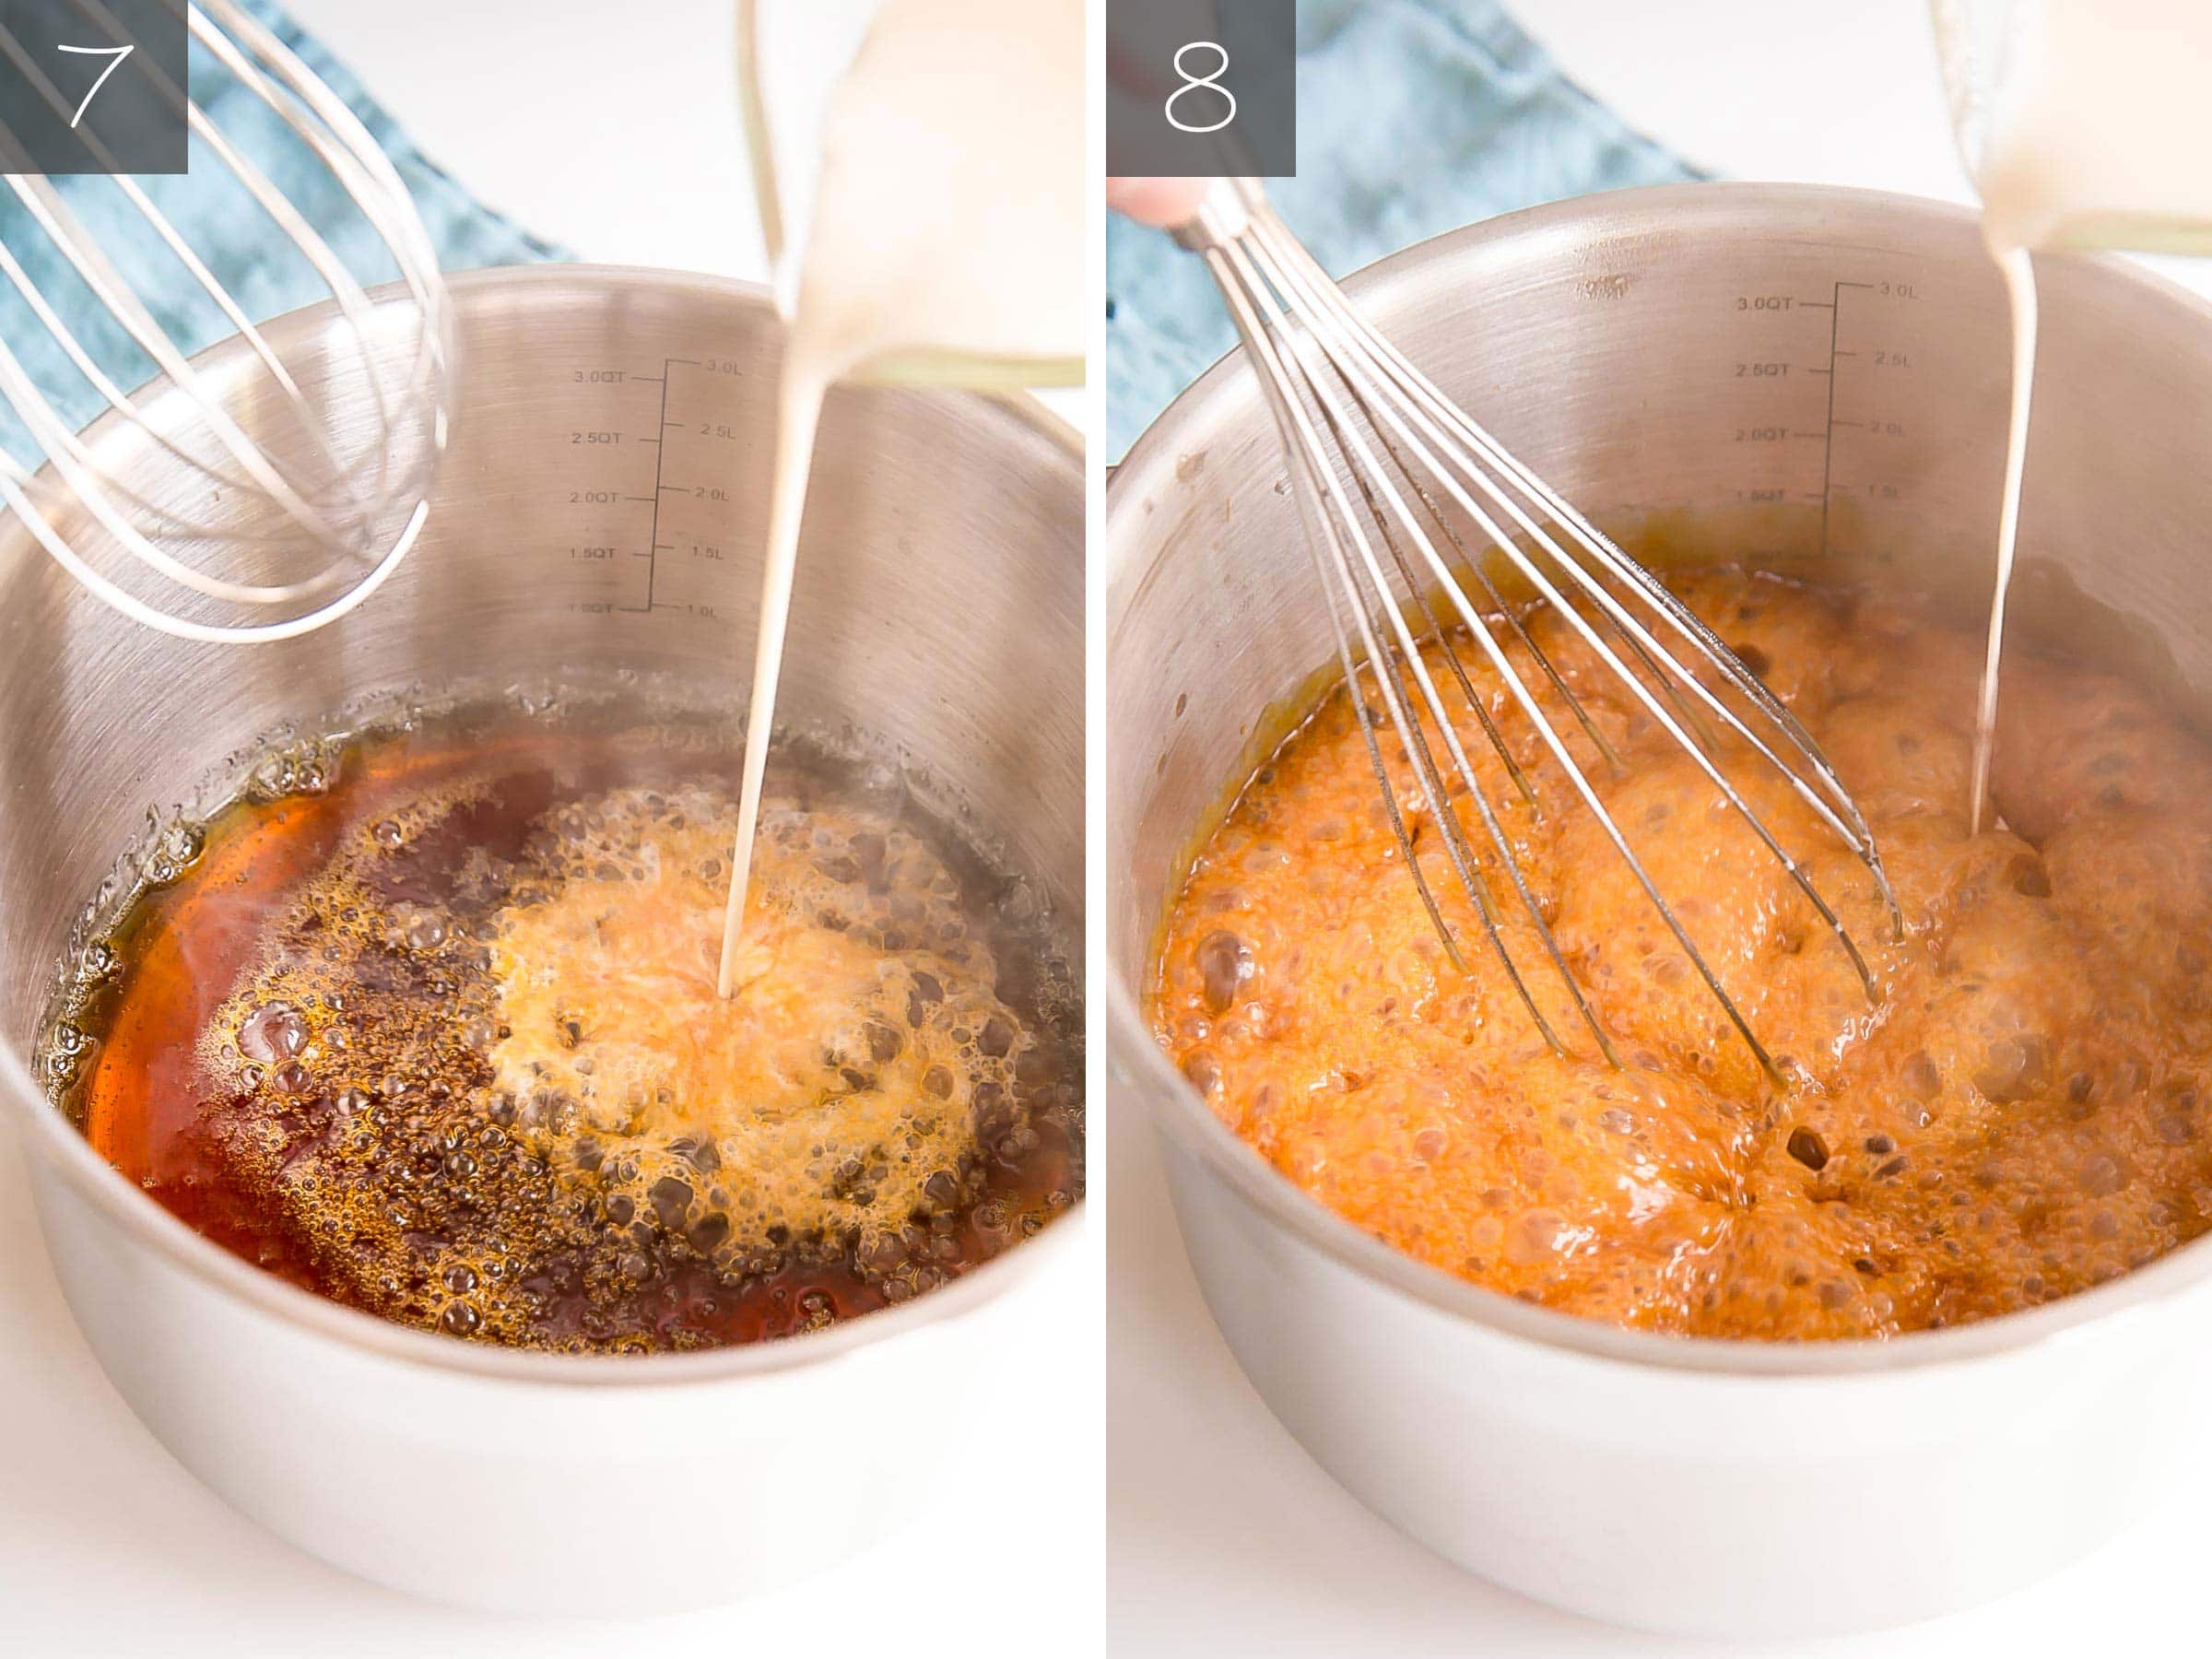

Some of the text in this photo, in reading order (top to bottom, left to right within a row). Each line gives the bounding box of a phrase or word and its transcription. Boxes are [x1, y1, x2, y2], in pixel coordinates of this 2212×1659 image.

[1880, 282, 1917, 300] 3.0L
[1737, 297, 1793, 311] 3.0QT
[707, 359, 743, 376] 3.0L
[574, 371, 627, 383] 3.0QT
[571, 432, 622, 444] 2.5QT
[569, 492, 619, 504] 2.0QT
[694, 487, 730, 502] 2.0L
